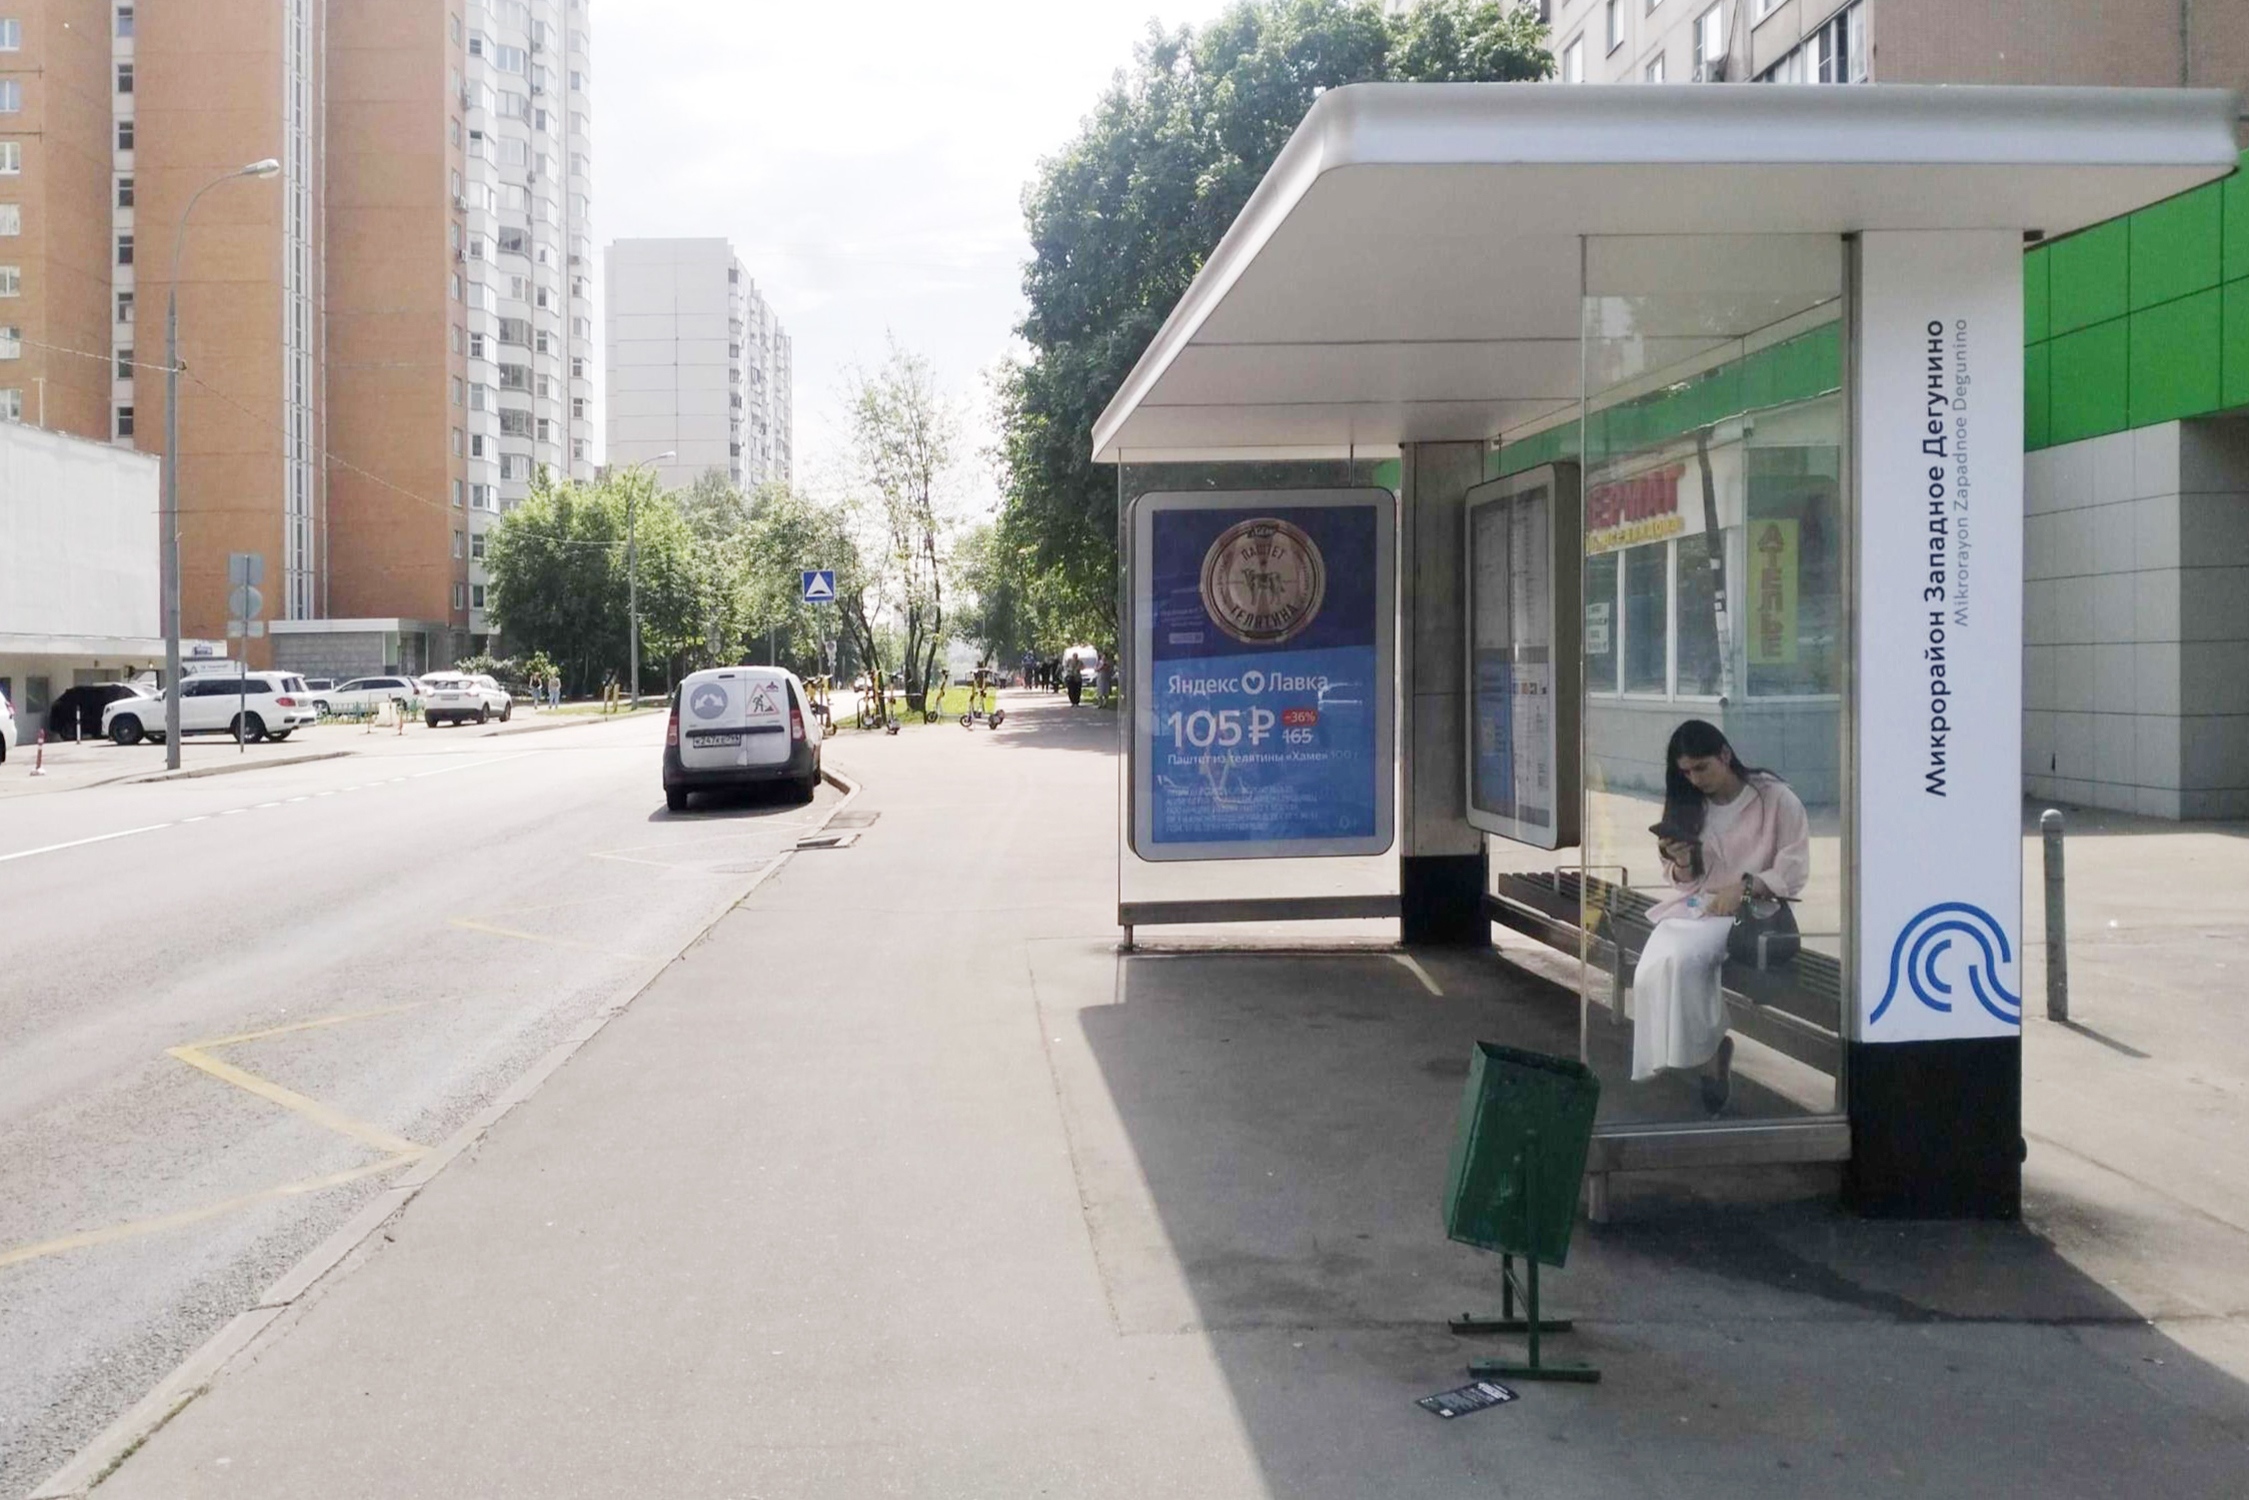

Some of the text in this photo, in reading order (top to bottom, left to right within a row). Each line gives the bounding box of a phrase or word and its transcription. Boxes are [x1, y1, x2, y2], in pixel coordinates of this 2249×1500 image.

[1952, 319, 1972, 628] Mikrorayon Zapadnoe Degunino
[1240, 543, 1286, 560] ПАШТЕТ
[1922, 320, 1952, 797] Микрорайон Западное Дегунино
[1757, 523, 1783, 657] АТЕЛЬЕ
[1230, 603, 1299, 628] ТЕЛЯТИНА
[1168, 672, 1328, 695] Яндекс Лавка
[1282, 728, 1313, 744] 165
[1168, 754, 1210, 765] Паштет
[1213, 755, 1226, 764] из
[1230, 752, 1284, 764] телятины
